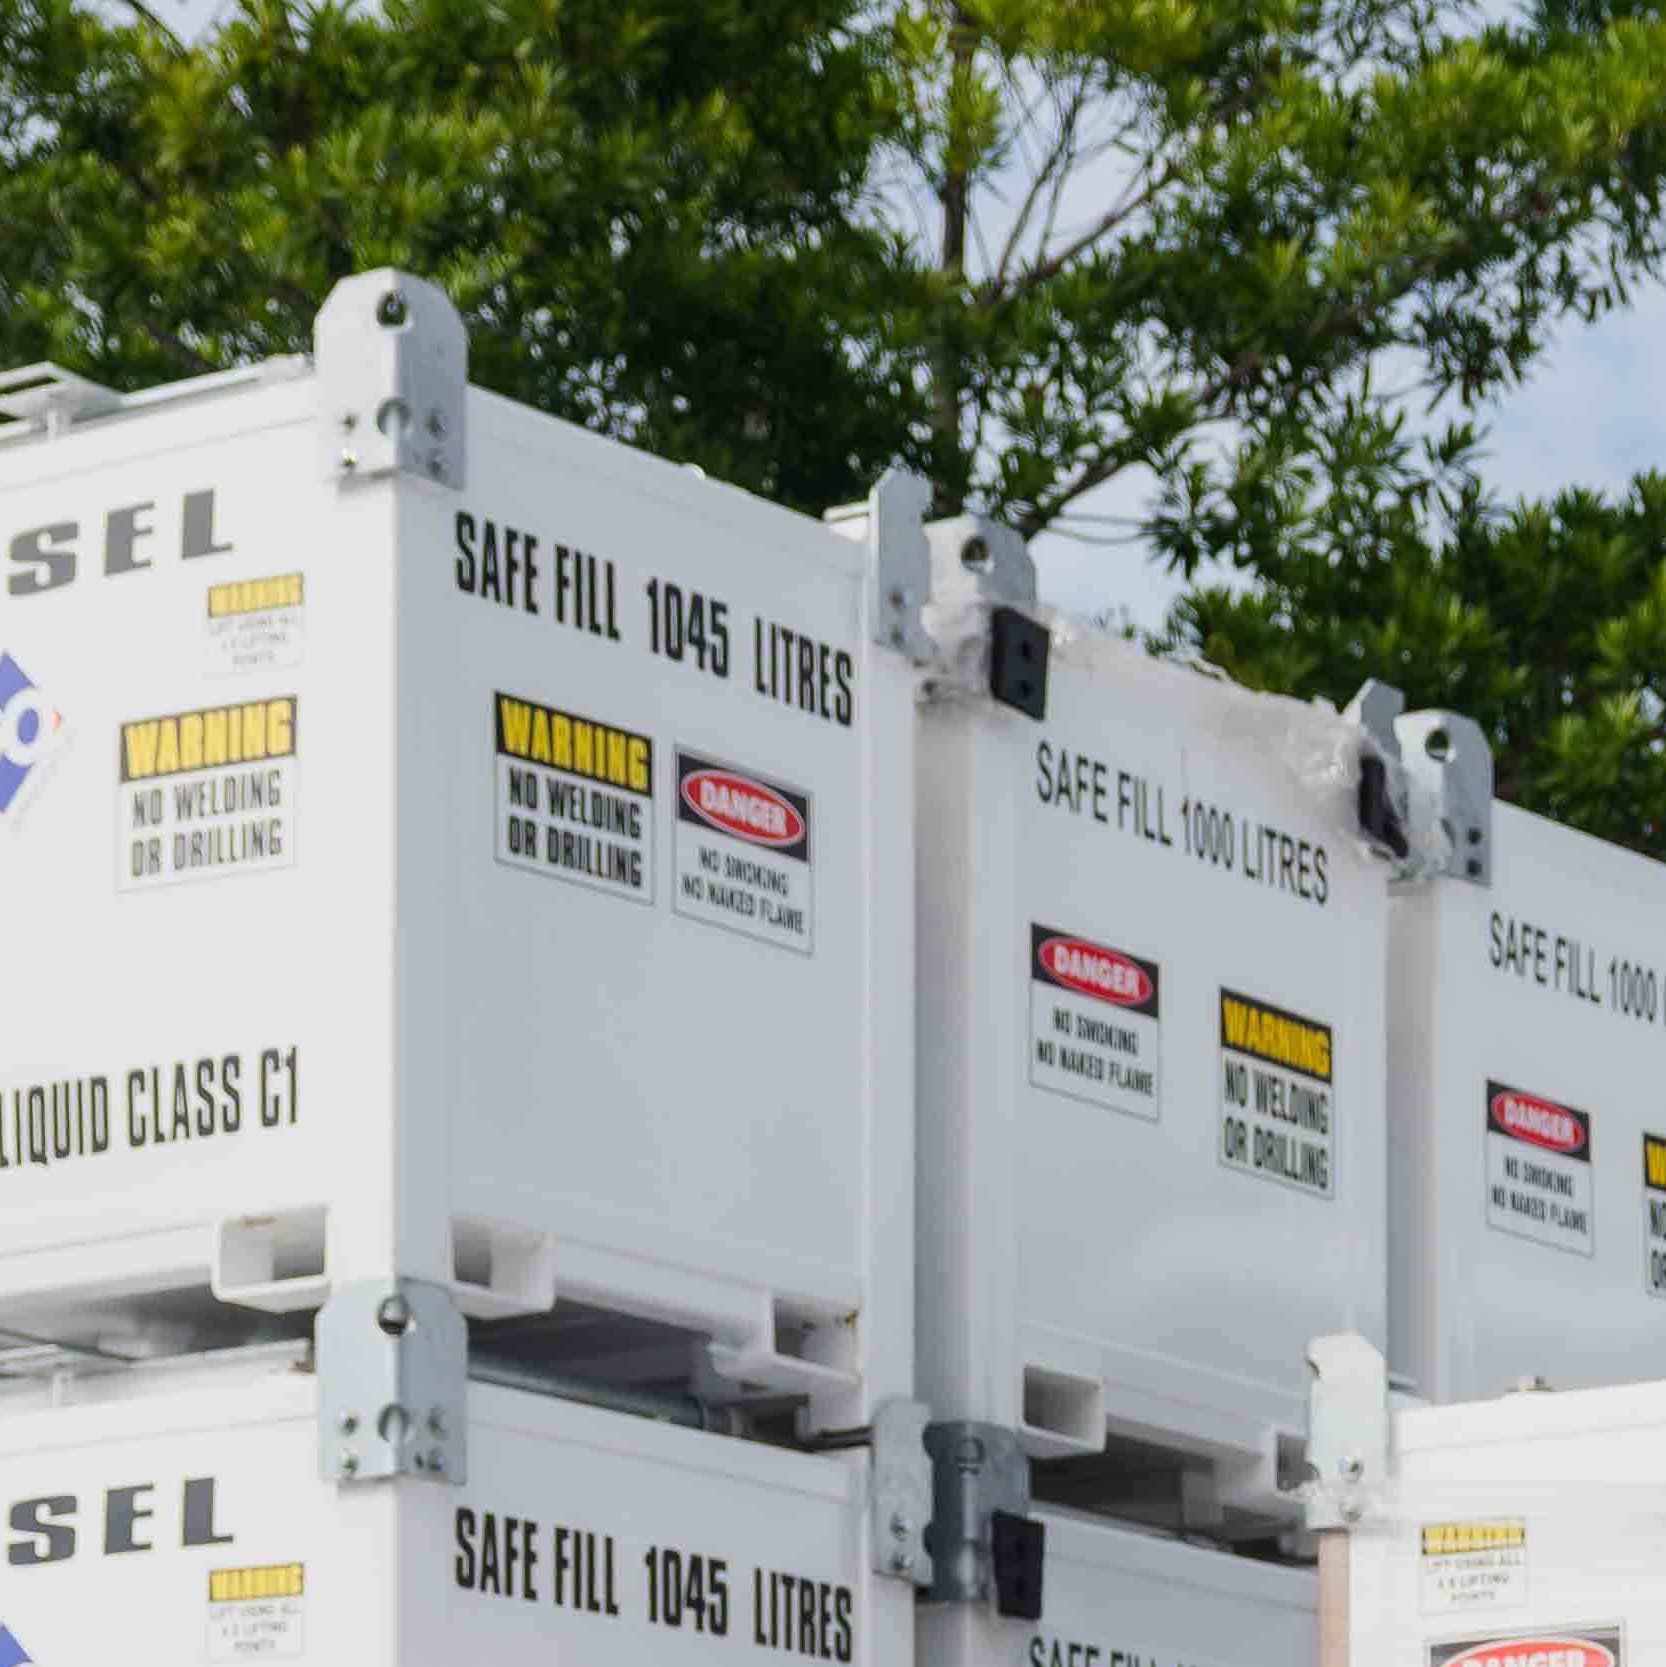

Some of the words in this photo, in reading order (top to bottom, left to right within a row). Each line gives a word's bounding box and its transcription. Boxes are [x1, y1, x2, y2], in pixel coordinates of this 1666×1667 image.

[455, 511, 539, 615] SAFE
[555, 544, 620, 642] FILL
[647, 577, 729, 678] 1045
[754, 617, 852, 727] LITRES
[123, 700, 293, 779] WARNING
[501, 698, 649, 793] WARNING
[133, 789, 163, 828] NO
[175, 769, 281, 820] WELDING
[509, 767, 537, 807] NO
[546, 776, 642, 840] WELDING
[700, 777, 788, 836] DANGER
[1036, 742, 1108, 823] SAFE
[1119, 771, 1172, 846] FILL
[1182, 796, 1234, 869] 1000
[1243, 818, 1328, 906] LITRES
[133, 839, 161, 876] OR
[174, 820, 283, 870] DRILLING
[508, 816, 537, 859] OR
[547, 827, 642, 889] DRILLING
[1490, 911, 1547, 984] SAFE
[1555, 936, 1600, 1004] FILL
[1608, 956, 1656, 1022] 1000
[1223, 997, 1330, 1076] WARNING
[127, 1055, 241, 1148] CLASS
[261, 1046, 299, 1128] C1
[1225, 1062, 1246, 1107] NO
[1256, 1070, 1328, 1134] WELDING
[1225, 1116, 1246, 1162] OR
[1254, 1125, 1328, 1190] DRILLING
[456, 1507, 537, 1602] SAFE
[555, 1526, 618, 1617] FILL
[645, 1545, 728, 1636] 1045
[754, 1567, 852, 1664] LITRES
